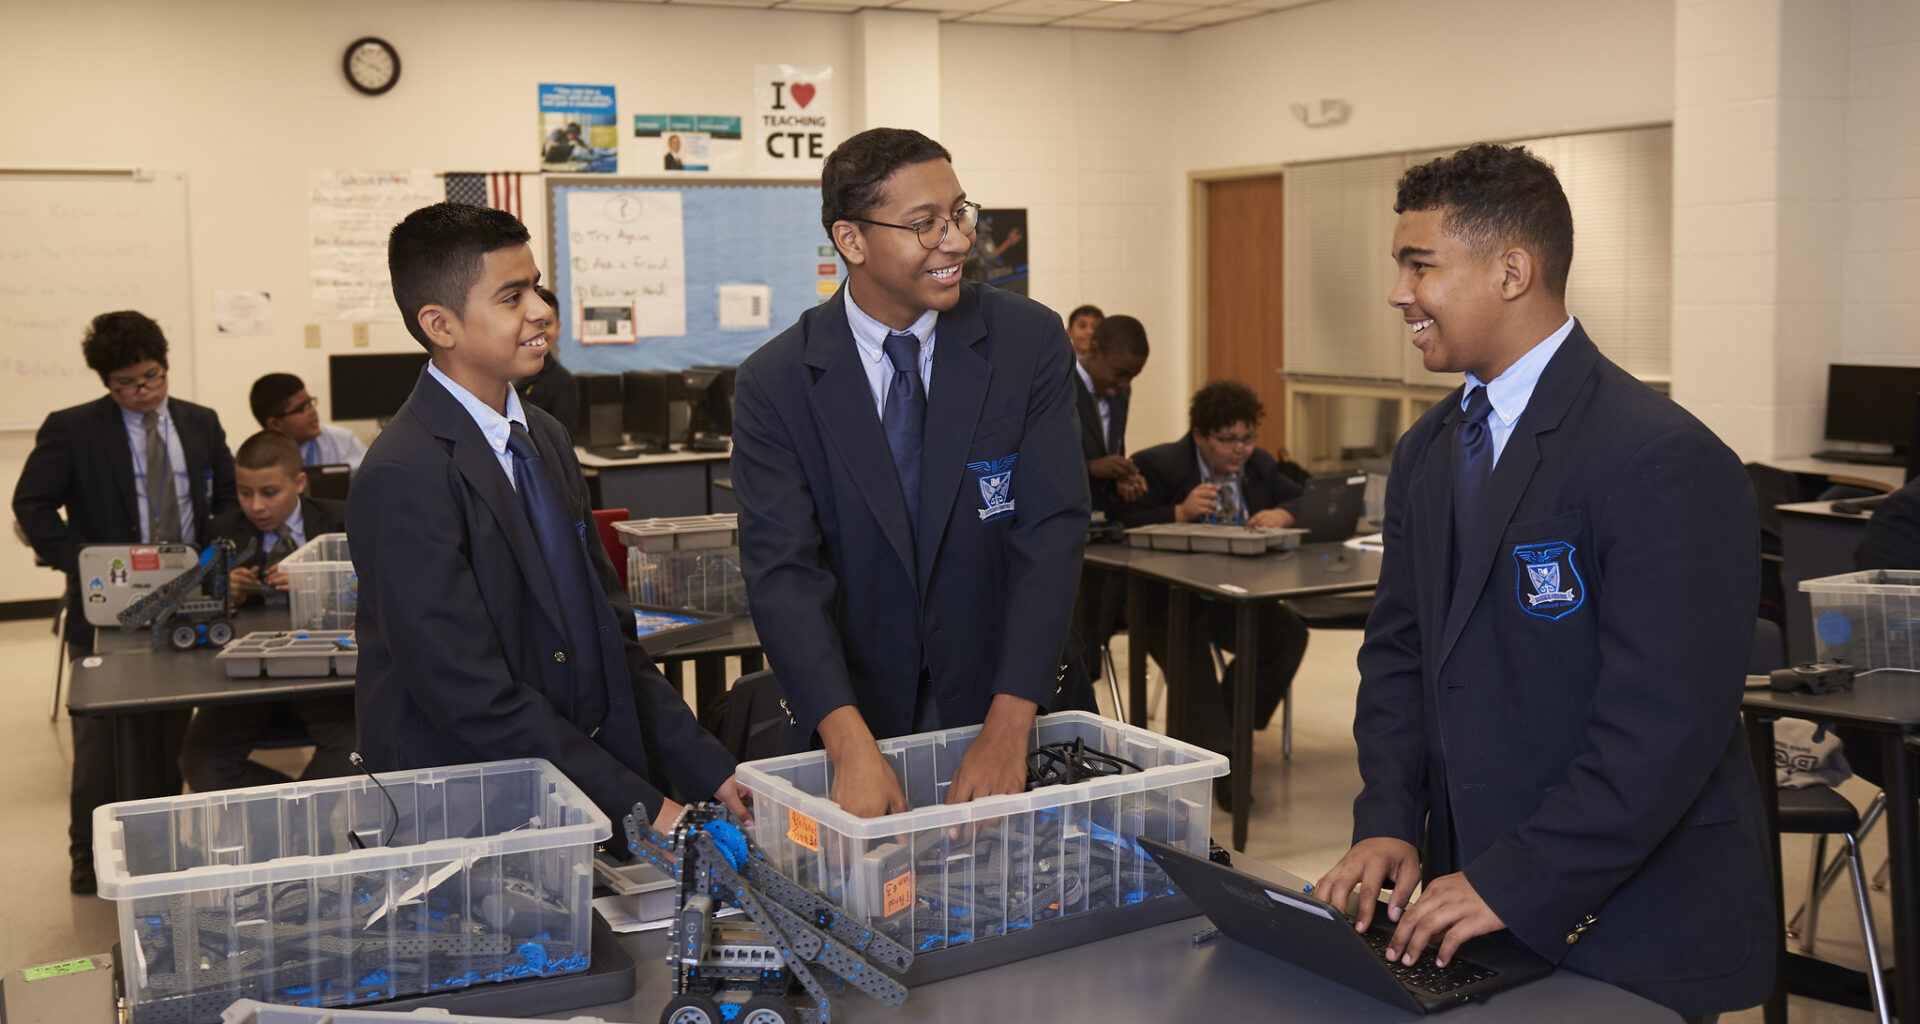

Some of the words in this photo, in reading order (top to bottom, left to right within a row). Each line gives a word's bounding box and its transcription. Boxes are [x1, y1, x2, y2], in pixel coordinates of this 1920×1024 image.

[771, 82, 785, 109] I
[763, 115, 826, 128] TEACHING
[766, 132, 824, 159] CTE
[586, 229, 610, 243] Try
